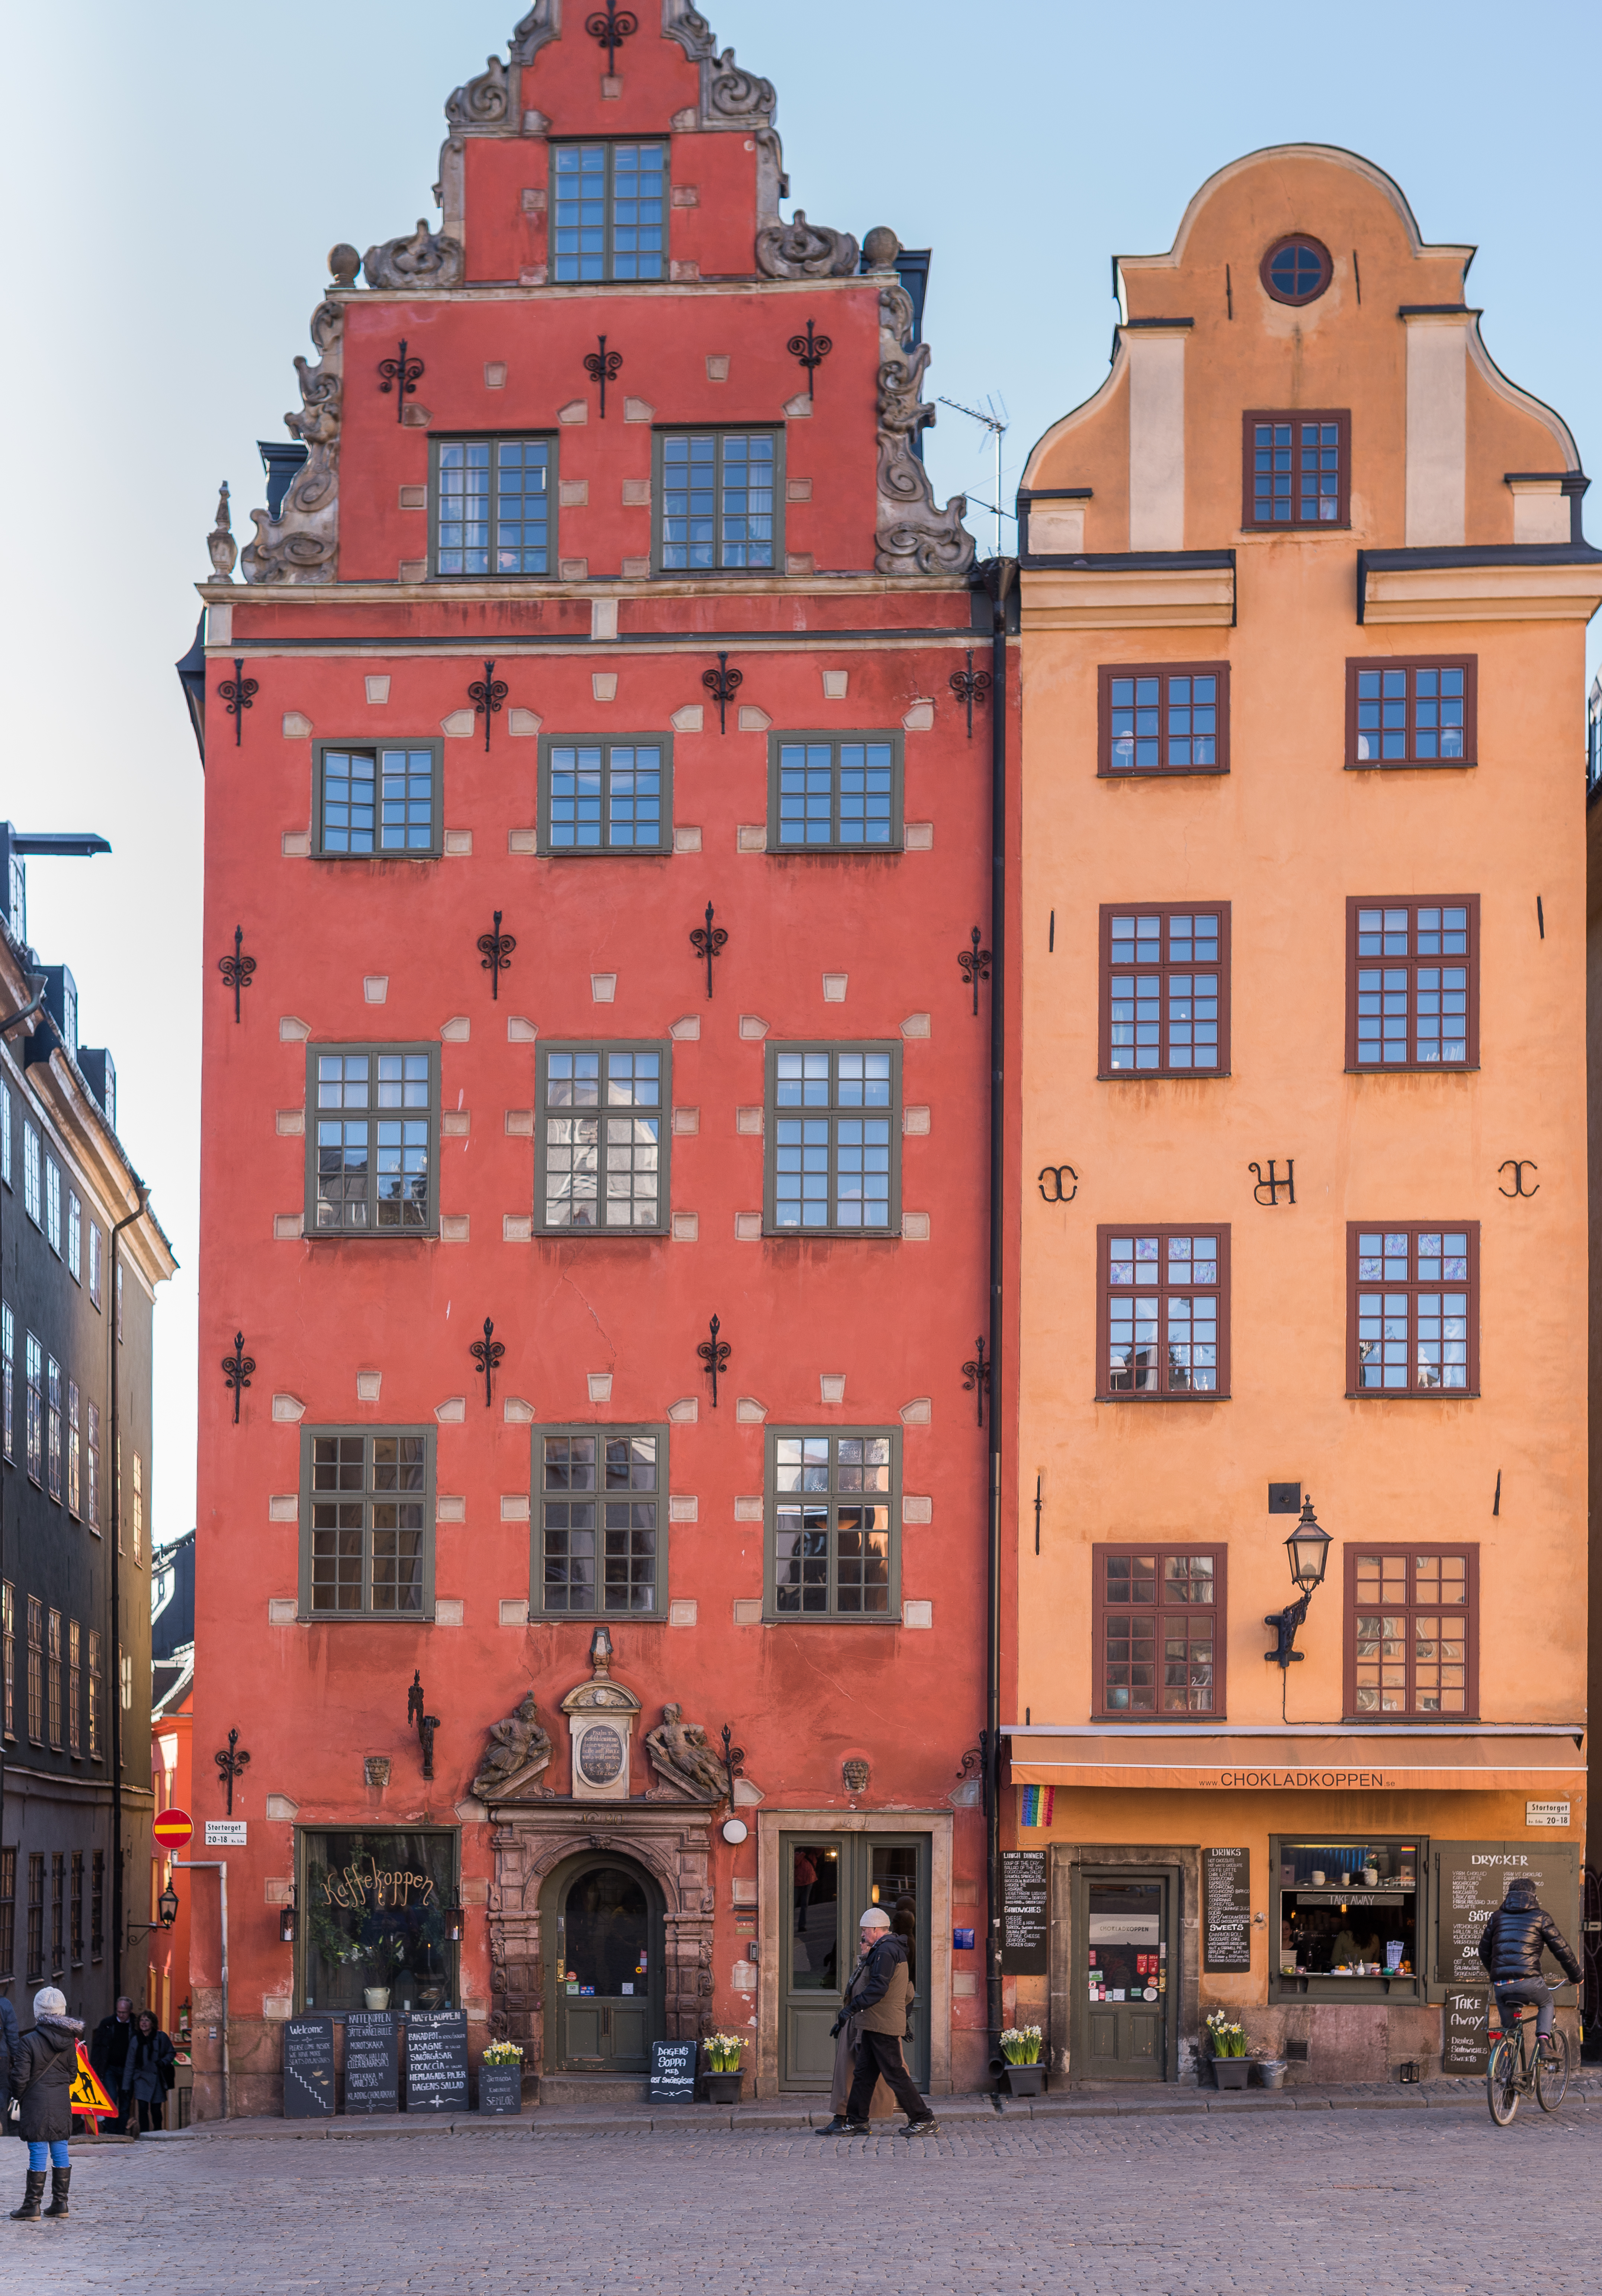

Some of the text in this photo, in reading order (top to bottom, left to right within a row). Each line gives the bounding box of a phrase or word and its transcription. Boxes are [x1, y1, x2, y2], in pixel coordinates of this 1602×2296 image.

[1532, 1804, 1567, 1813] Stortorget
[208, 1824, 241, 1832] Stortorget
[1471, 1855, 1529, 1867] DRYCKER
[320, 1857, 433, 1907] Kaffekoppen
[1327, 1895, 1374, 1905] TAKE AWAY
[1450, 1994, 1482, 2010] TAKE
[1451, 2013, 1484, 2031] AWAY
[290, 2025, 323, 2034] Welcome
[1451, 2036, 1474, 2045] DRINKS
[409, 2042, 443, 2051] LASAGNE
[657, 2046, 688, 2056] DAGENS
[410, 2050, 453, 2061] SMÖRGÅSAR
[1451, 2054, 1477, 2062] SWEETS
[410, 2060, 445, 2071] FOCACCIA
[658, 2056, 686, 2067] SOPPA
[410, 2072, 446, 2081] HEMLAGADE
[412, 2081, 464, 2091] DAGENS SALLAD
[486, 2095, 515, 2106] SEMLOR
